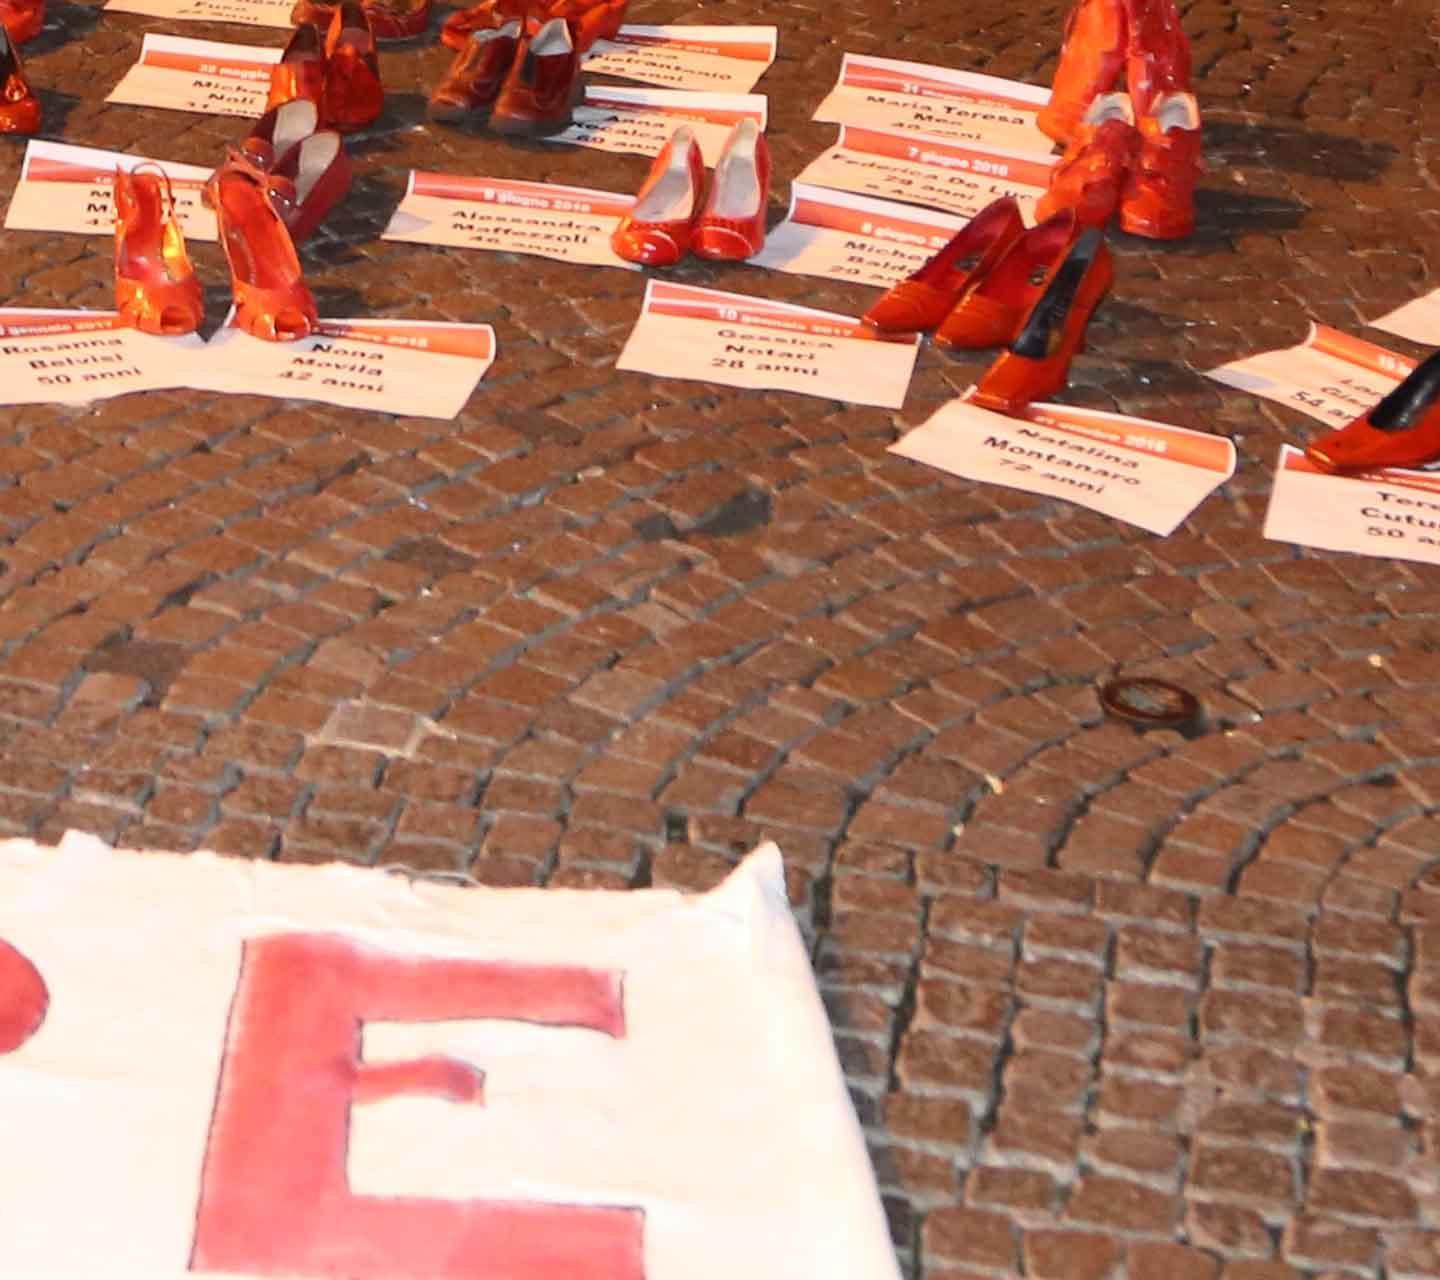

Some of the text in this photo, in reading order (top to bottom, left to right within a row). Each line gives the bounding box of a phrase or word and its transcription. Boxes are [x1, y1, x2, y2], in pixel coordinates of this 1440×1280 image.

[866, 94, 1025, 127] Maria Teresa
[497, 191, 549, 210] giugno
[450, 210, 602, 232] Alessandra
[0, 338, 124, 356] Rosanna
[311, 342, 385, 361] Nona
[723, 343, 818, 362] Notari
[80, 365, 143, 382] anni
[753, 362, 820, 378] anni
[320, 377, 385, 393] anni
[1016, 427, 1142, 468] Natalina
[983, 435, 1143, 486] Montanaro
[1038, 472, 1106, 494] anni
[1366, 524, 1407, 540] 50
